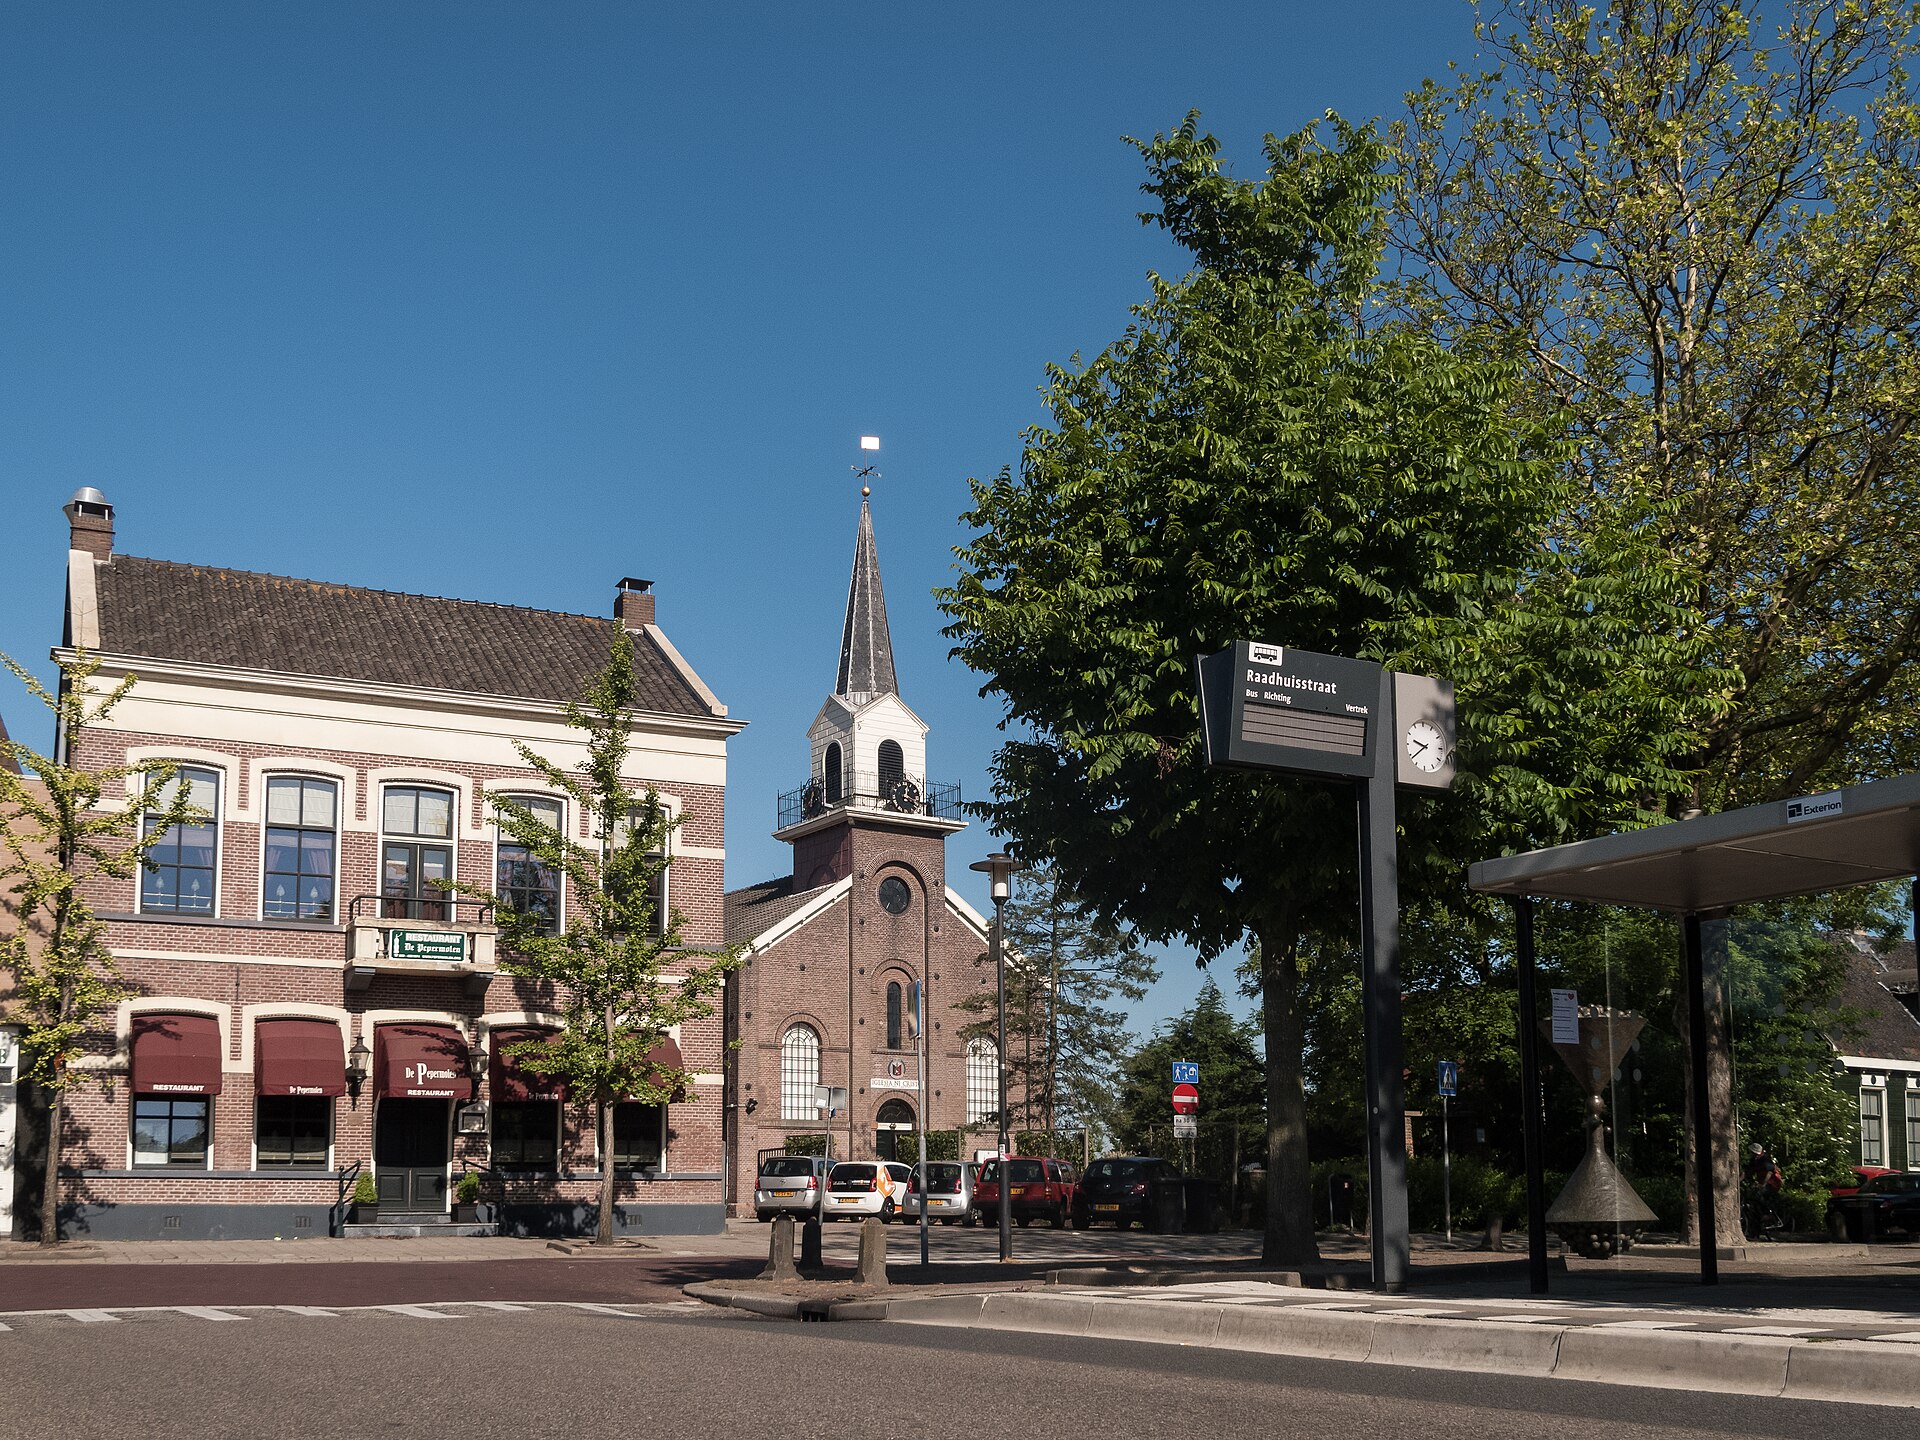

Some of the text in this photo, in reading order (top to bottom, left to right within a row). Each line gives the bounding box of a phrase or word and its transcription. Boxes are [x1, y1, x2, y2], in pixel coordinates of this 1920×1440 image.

[1246, 669, 1337, 694] Raadhuisstraat
[1245, 689, 1292, 704] Bus Richting
[1345, 703, 1369, 714] Vertrek
[1803, 801, 1842, 815] Exterion
[405, 932, 462, 944] RESTAURANT
[404, 942, 461, 953] De Pepermolen
[405, 1062, 457, 1085] De Pepermolen
[152, 1084, 205, 1092] RESTAURANT
[407, 1089, 455, 1097] RESTAURANT
